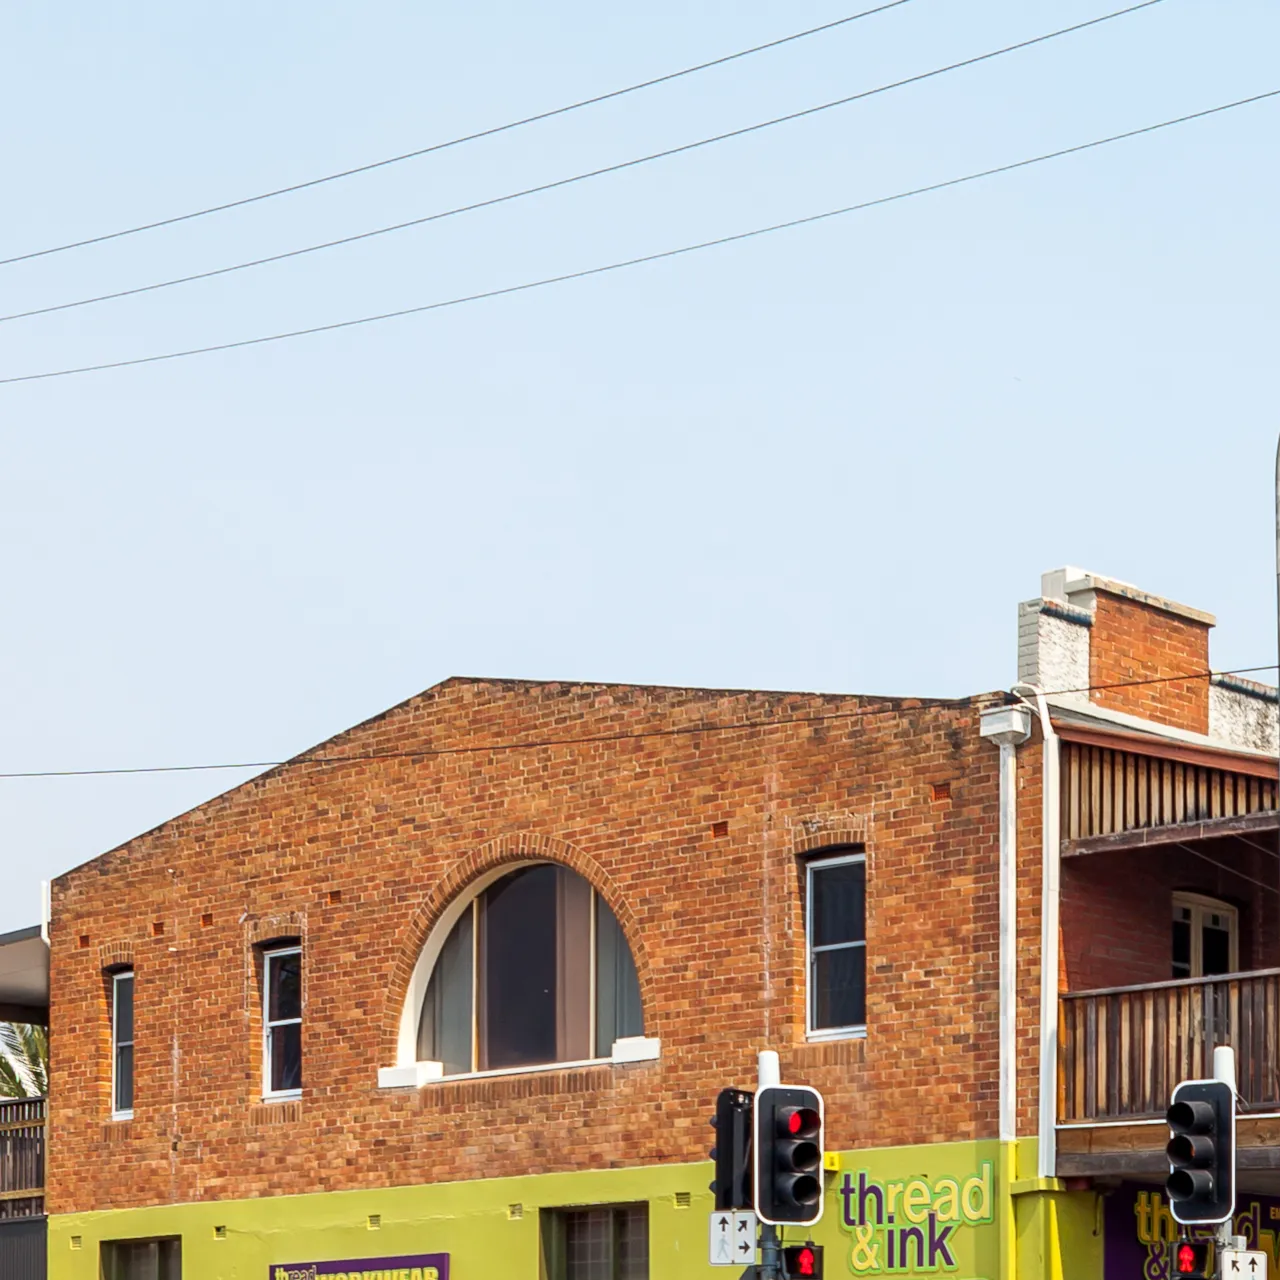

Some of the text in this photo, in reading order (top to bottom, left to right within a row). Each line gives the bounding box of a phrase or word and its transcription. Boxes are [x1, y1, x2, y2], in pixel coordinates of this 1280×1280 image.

[840, 1163, 991, 1226] thread
[852, 1212, 954, 1270] & ink
